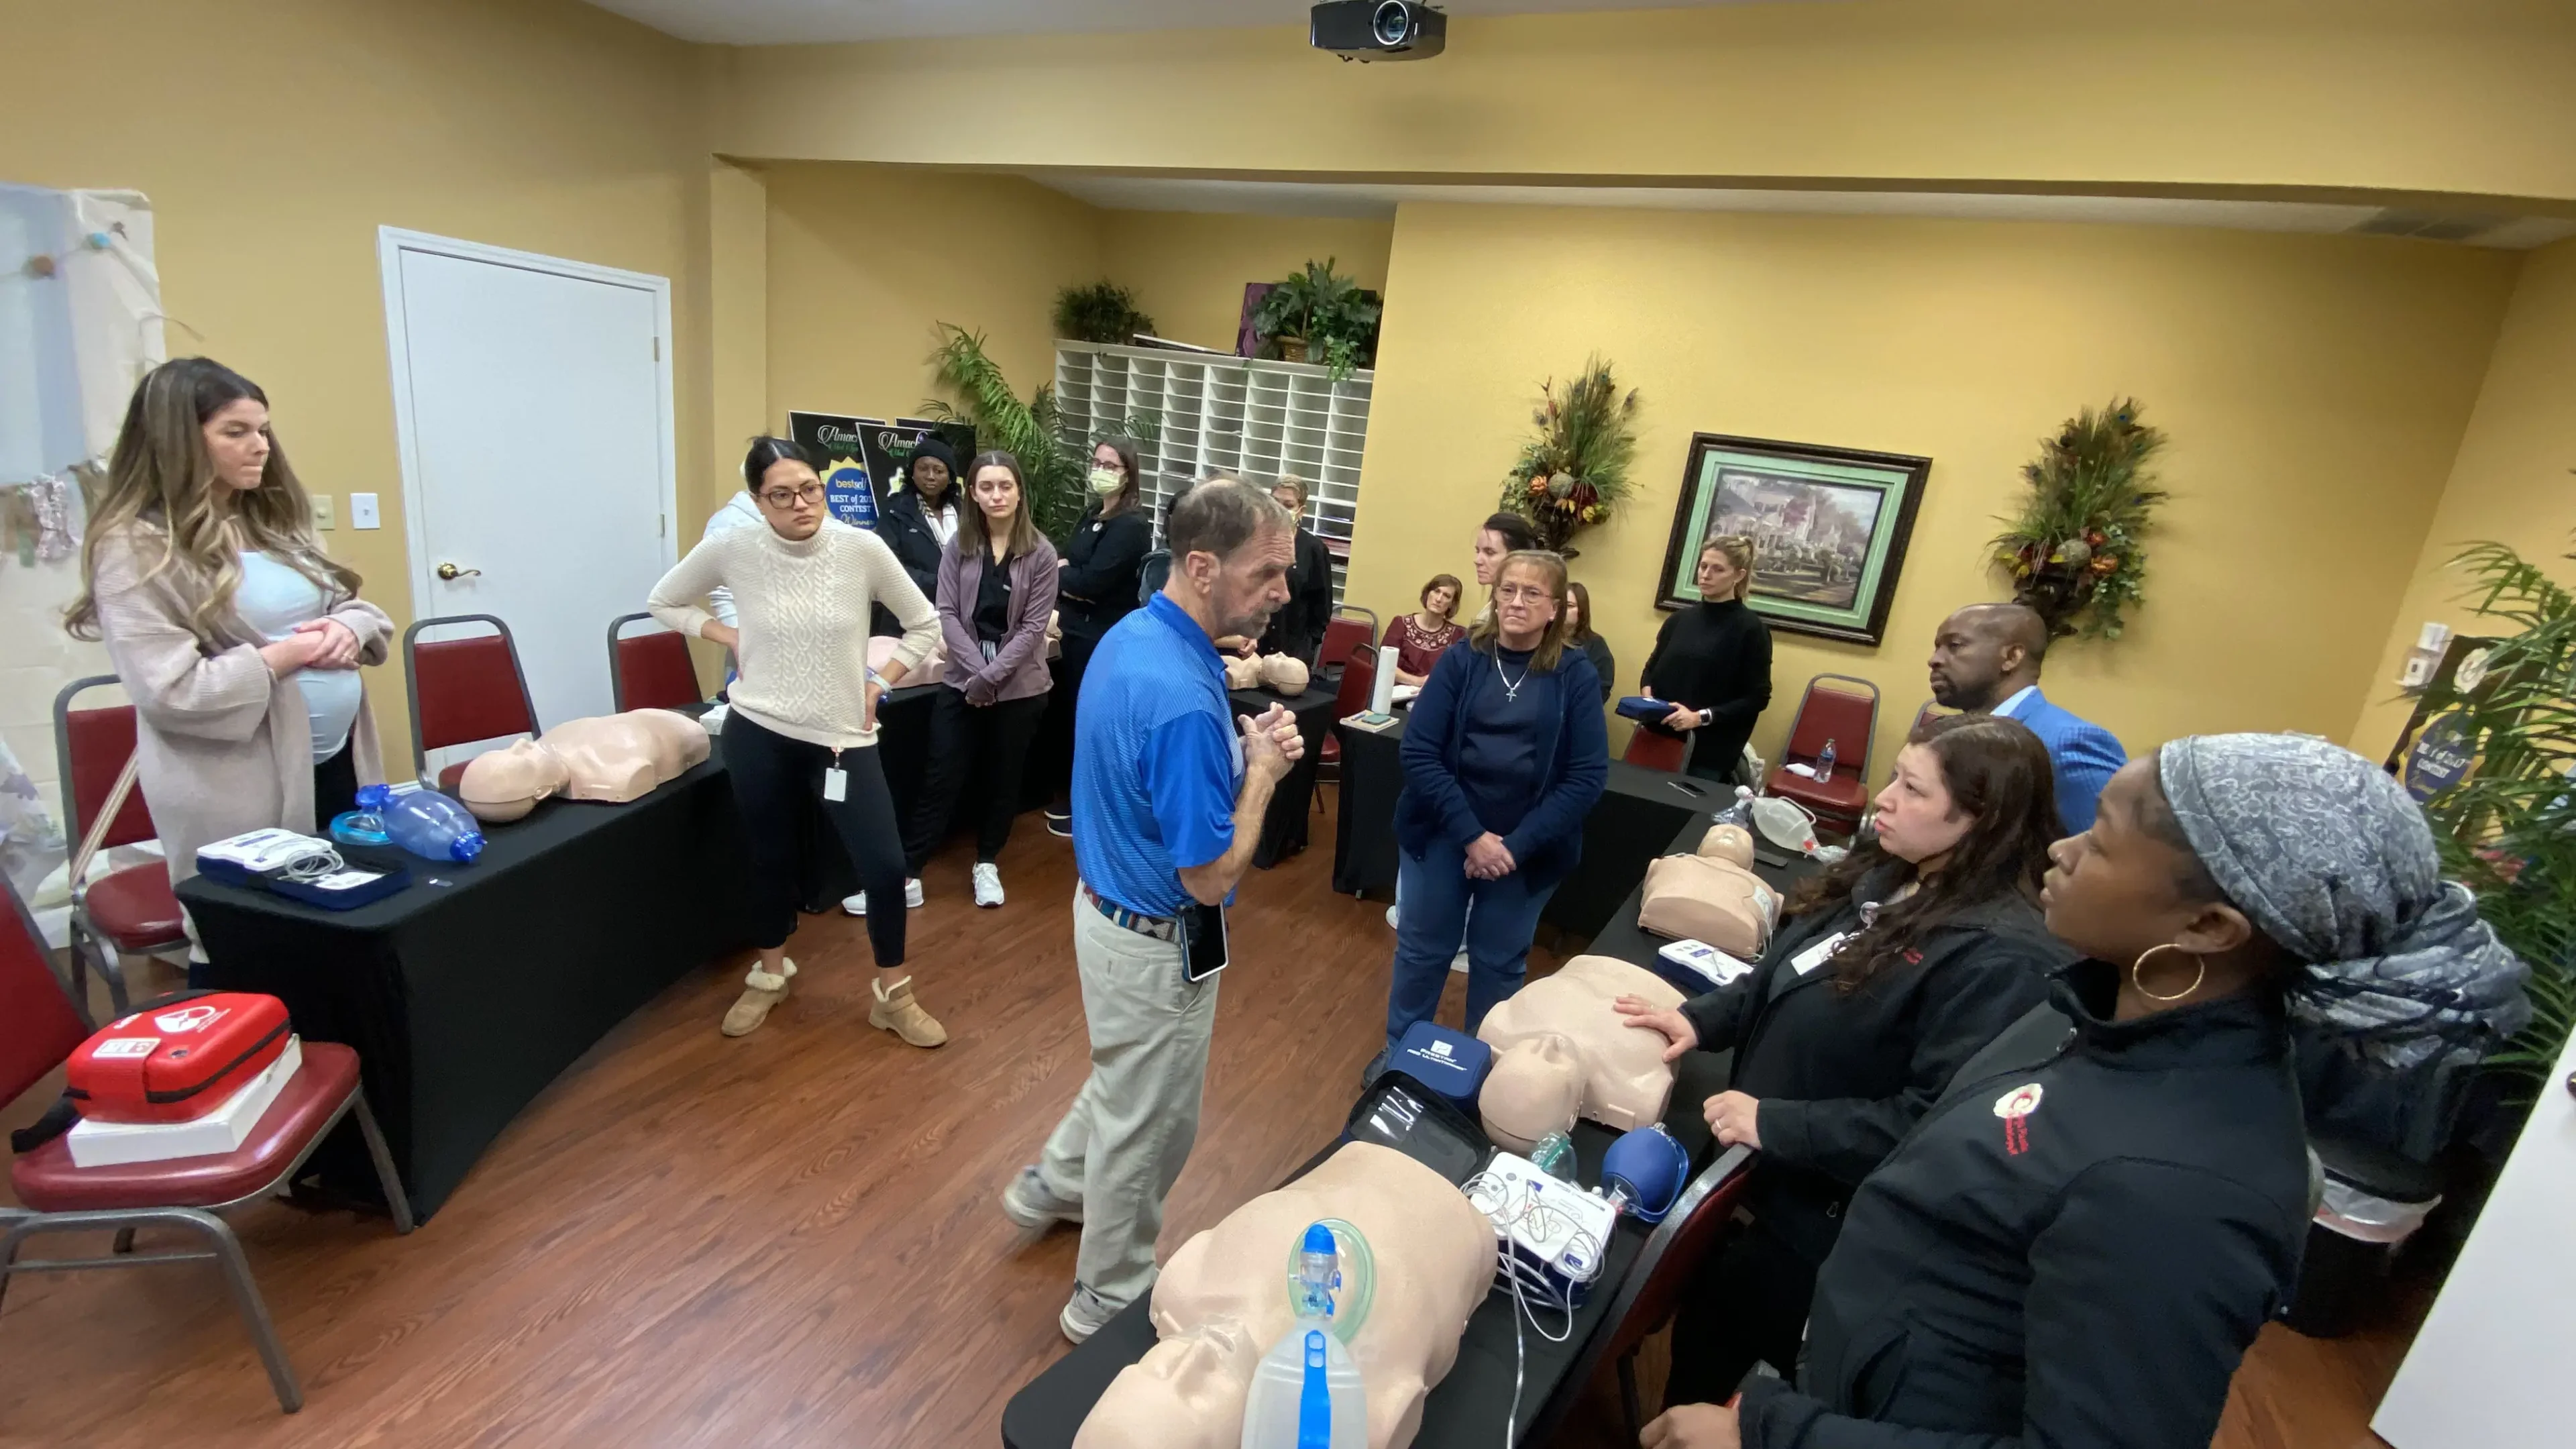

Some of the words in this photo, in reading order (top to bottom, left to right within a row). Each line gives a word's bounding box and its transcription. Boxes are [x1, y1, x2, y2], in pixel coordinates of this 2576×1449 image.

[830, 494, 849, 503] BEST
[851, 494, 858, 504] of
[859, 495, 873, 503] 201
[839, 504, 871, 513] CONTEST
